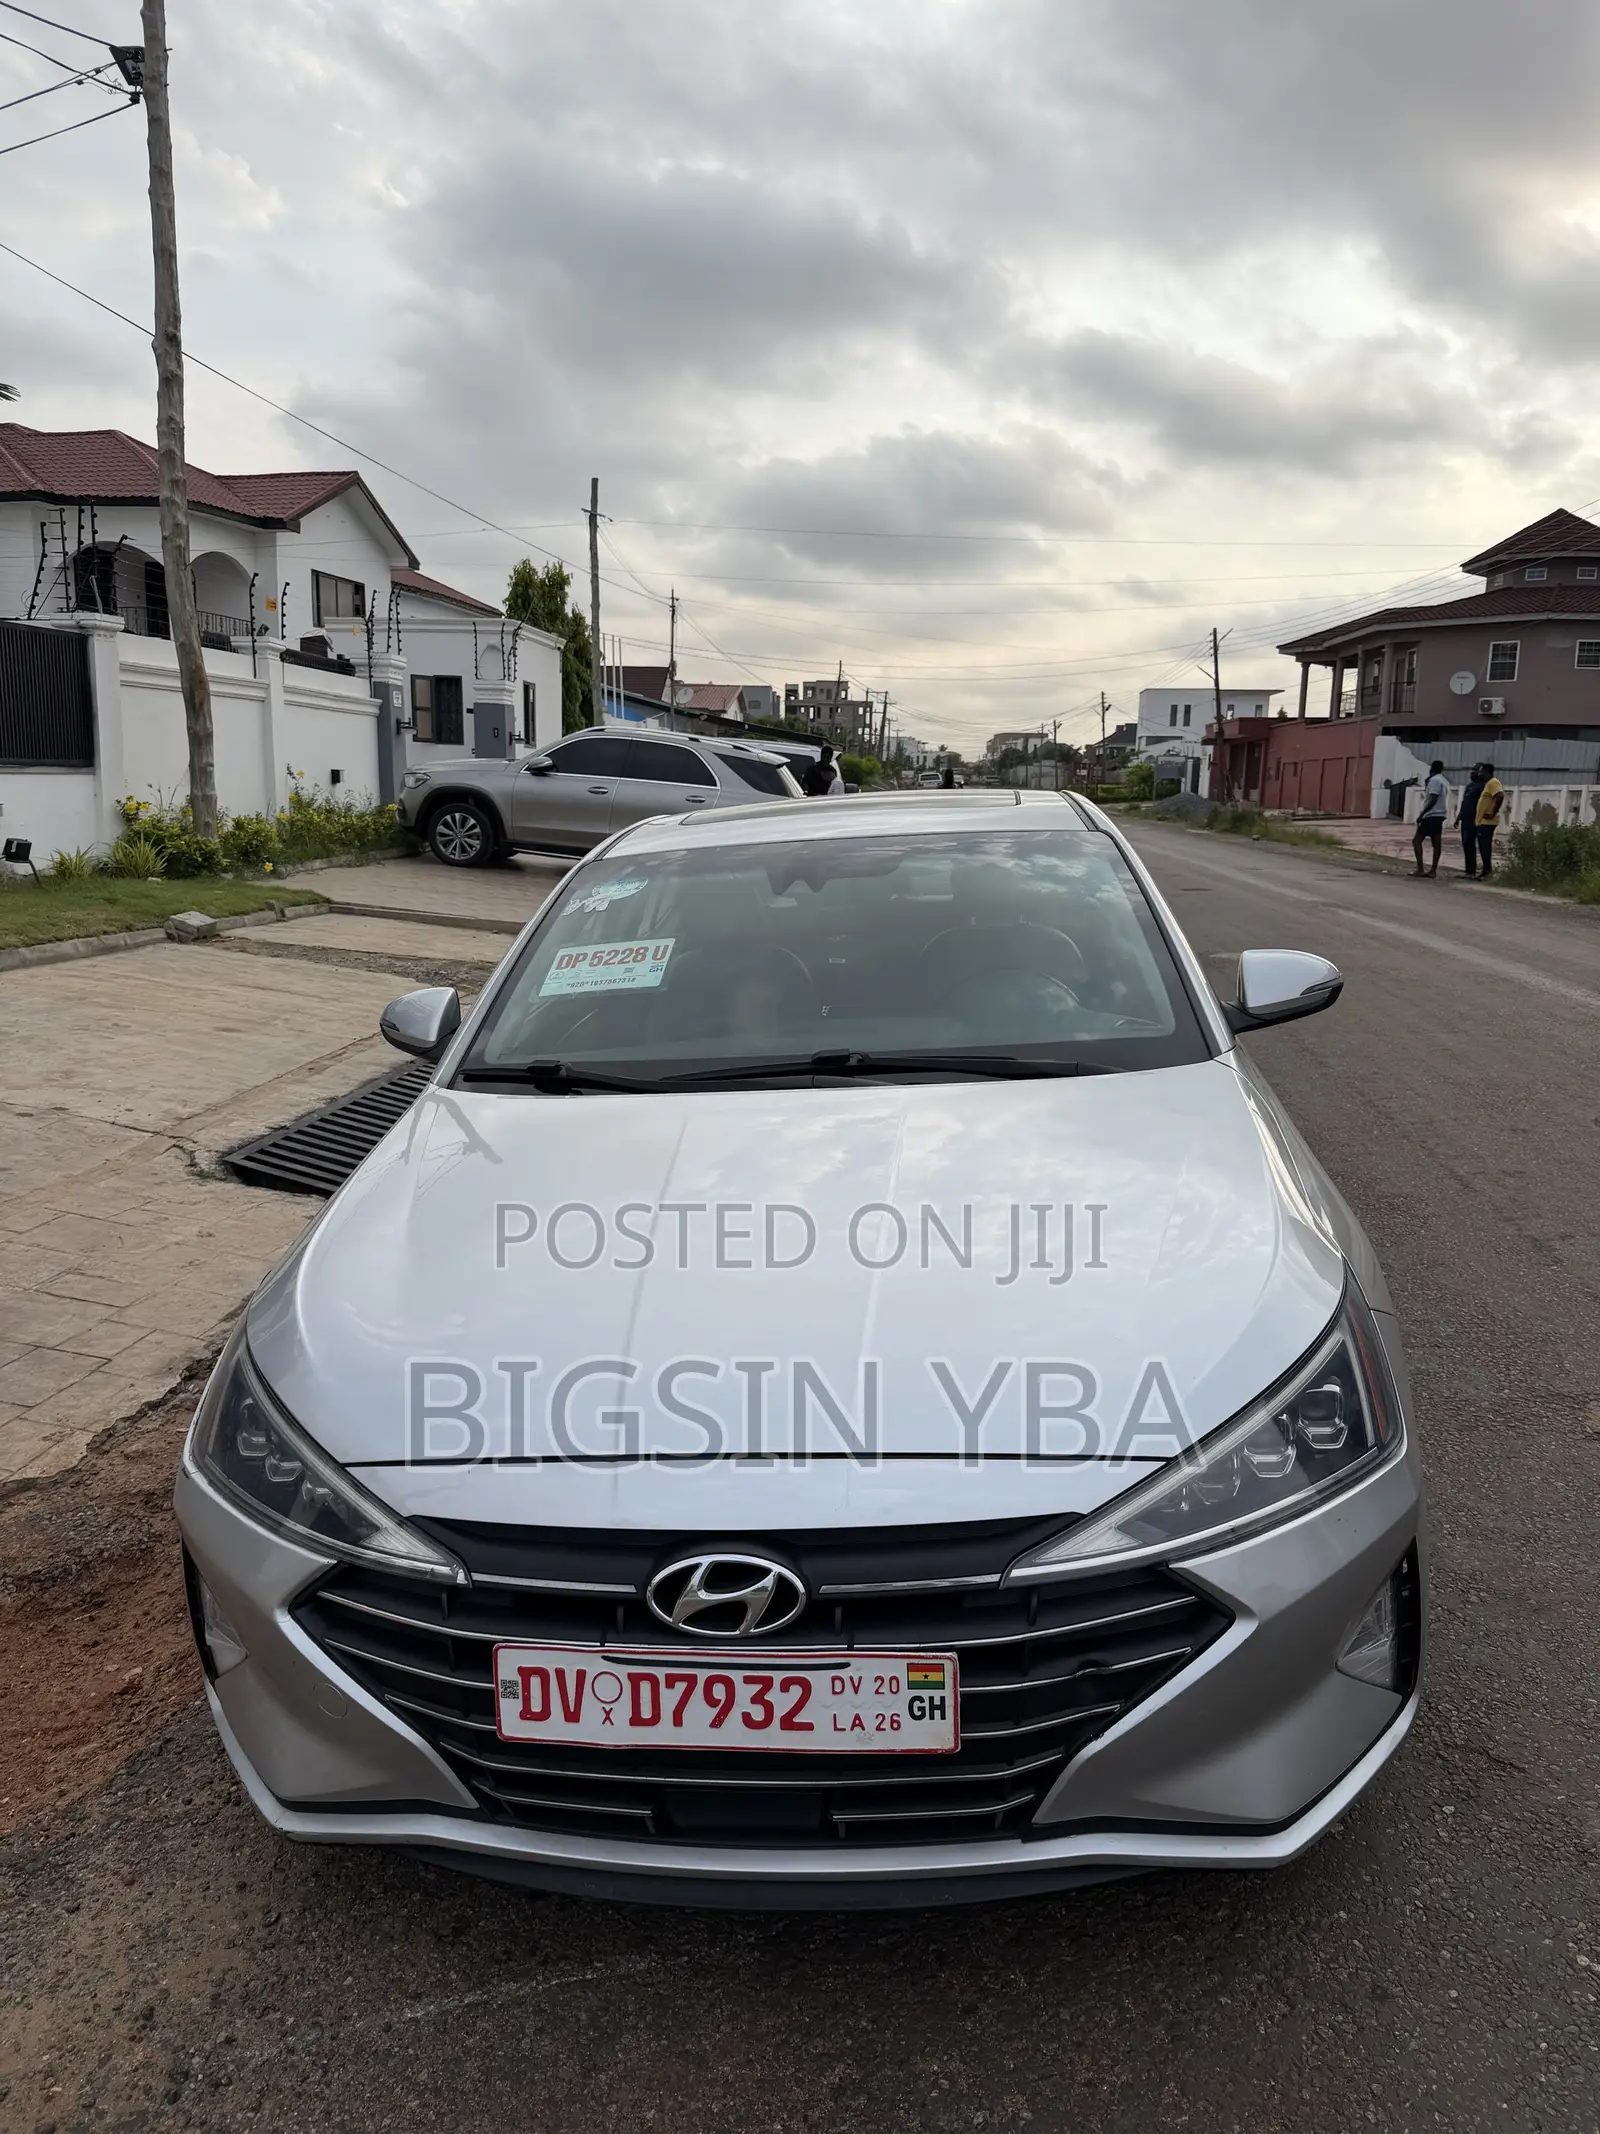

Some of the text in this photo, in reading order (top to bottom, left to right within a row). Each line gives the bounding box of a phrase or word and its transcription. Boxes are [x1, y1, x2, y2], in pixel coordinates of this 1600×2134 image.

[556, 944, 670, 970] DP 5228 U
[830, 1675, 900, 1695] DV 20
[517, 1665, 815, 1732] DV D7932
[908, 1695, 947, 1721] GH
[833, 1713, 902, 1732] LA 26
